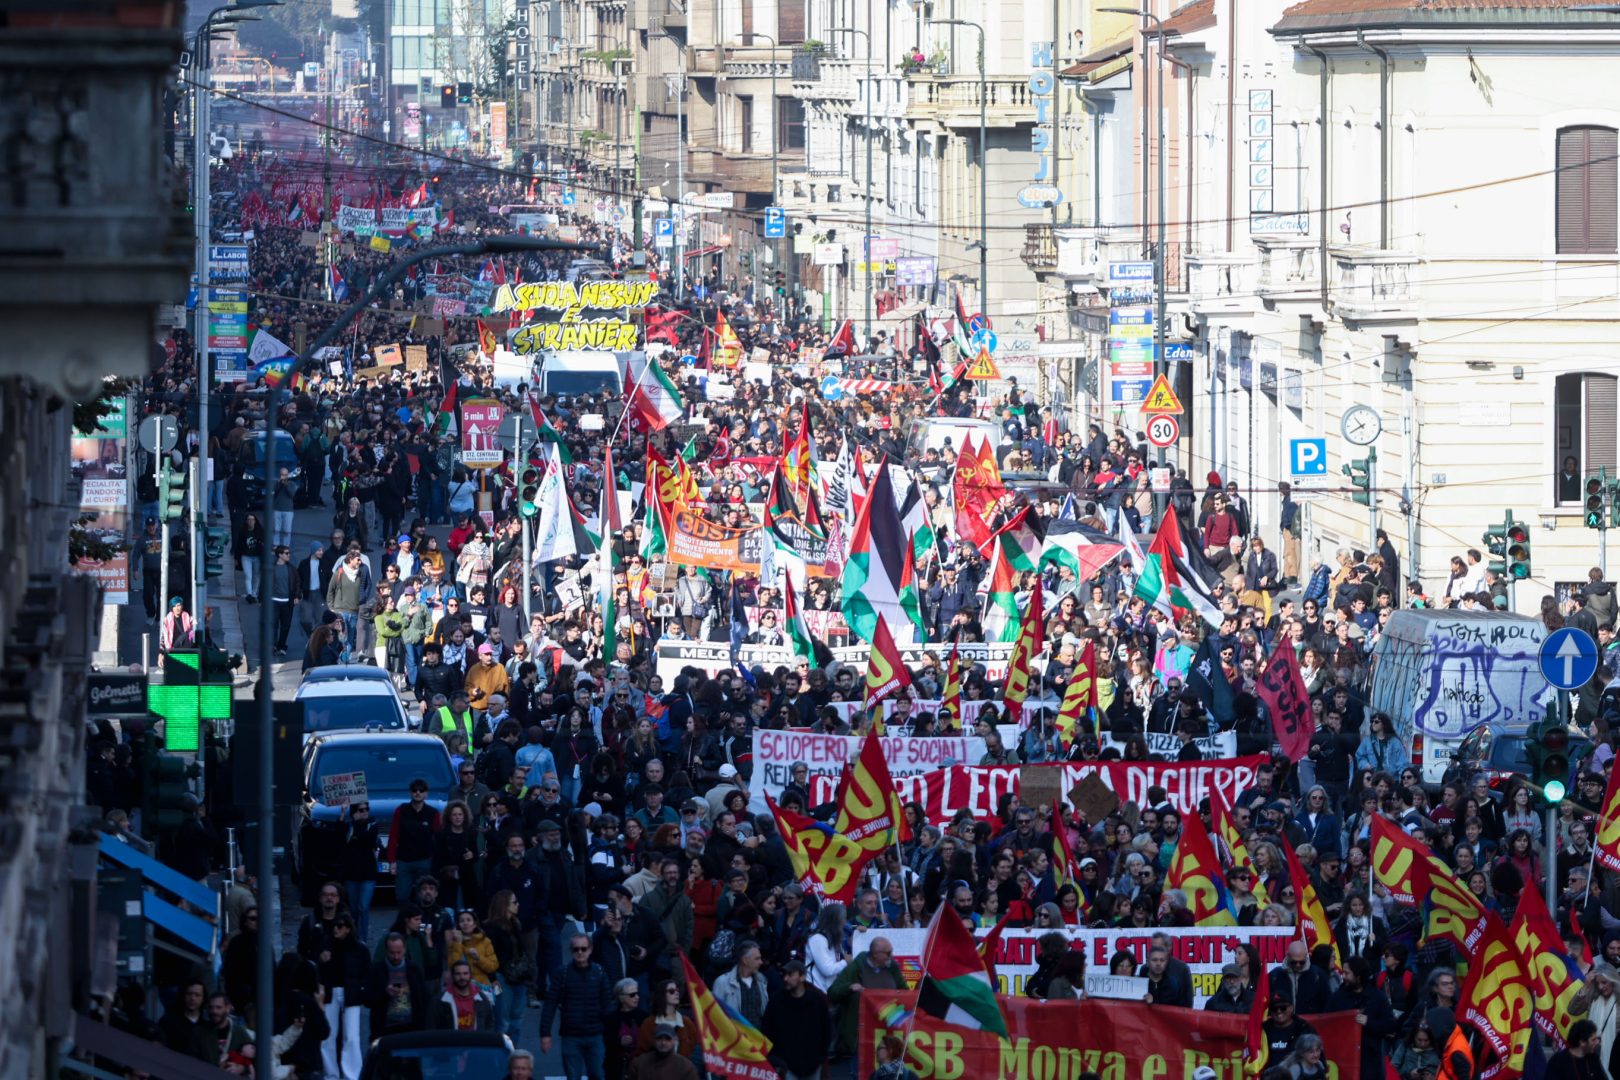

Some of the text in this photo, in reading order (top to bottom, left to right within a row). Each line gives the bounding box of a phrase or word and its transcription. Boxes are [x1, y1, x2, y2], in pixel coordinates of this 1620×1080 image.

[516, 9, 529, 91] HOTEL
[659, 221, 670, 234] P
[496, 284, 514, 311] A
[514, 282, 577, 310] SCUOLA
[1164, 346, 1193, 359] Eden
[464, 412, 484, 420] 5 min
[1154, 424, 1171, 438] 30
[760, 732, 848, 762] SCIOPERO
[907, 738, 967, 764] SOCIALI
[1094, 936, 1108, 966] E
[1142, 1053, 1168, 1080] e
